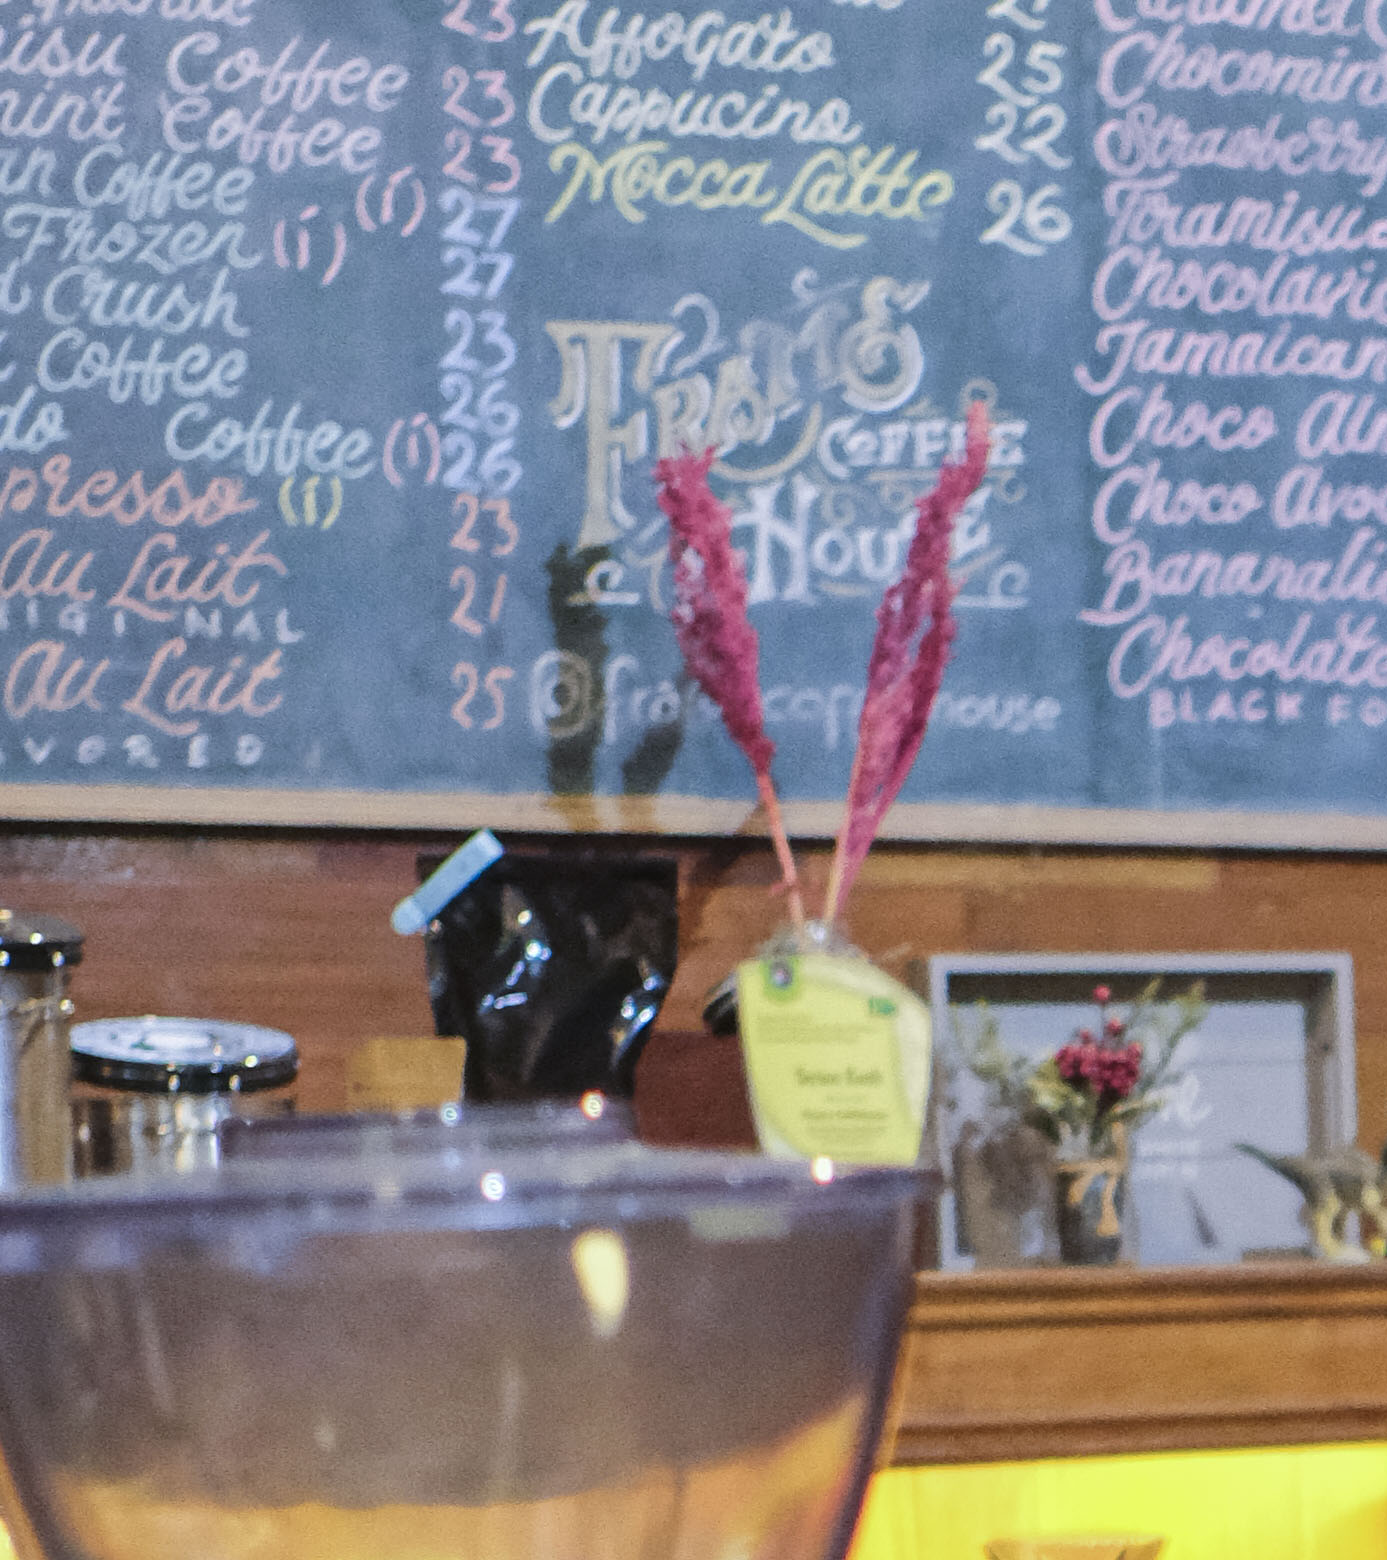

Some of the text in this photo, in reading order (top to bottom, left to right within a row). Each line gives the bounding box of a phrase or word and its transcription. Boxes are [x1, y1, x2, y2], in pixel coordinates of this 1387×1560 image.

[165, 31, 410, 112] Coffee
[440, 65, 516, 127] 23
[528, 60, 1072, 171] Cappucino 22
[976, 30, 1068, 106] 25
[160, 92, 383, 174] Coffee
[440, 129, 523, 193] 23
[73, 143, 257, 221] Coffee
[437, 186, 521, 248] 27
[545, 140, 1073, 257] Mocca Latte 26
[3, 201, 516, 298] Frozen 27
[42, 266, 518, 377] Crush 23
[37, 326, 521, 436] Coffee 26
[1089, 382, 1279, 469] Choco
[164, 398, 378, 480] Coffee
[449, 492, 521, 557] 23
[730, 471, 993, 605] HOUE
[1091, 458, 1263, 544] Choco
[107, 530, 509, 636] Lait 21
[122, 636, 517, 737] Lait 25
